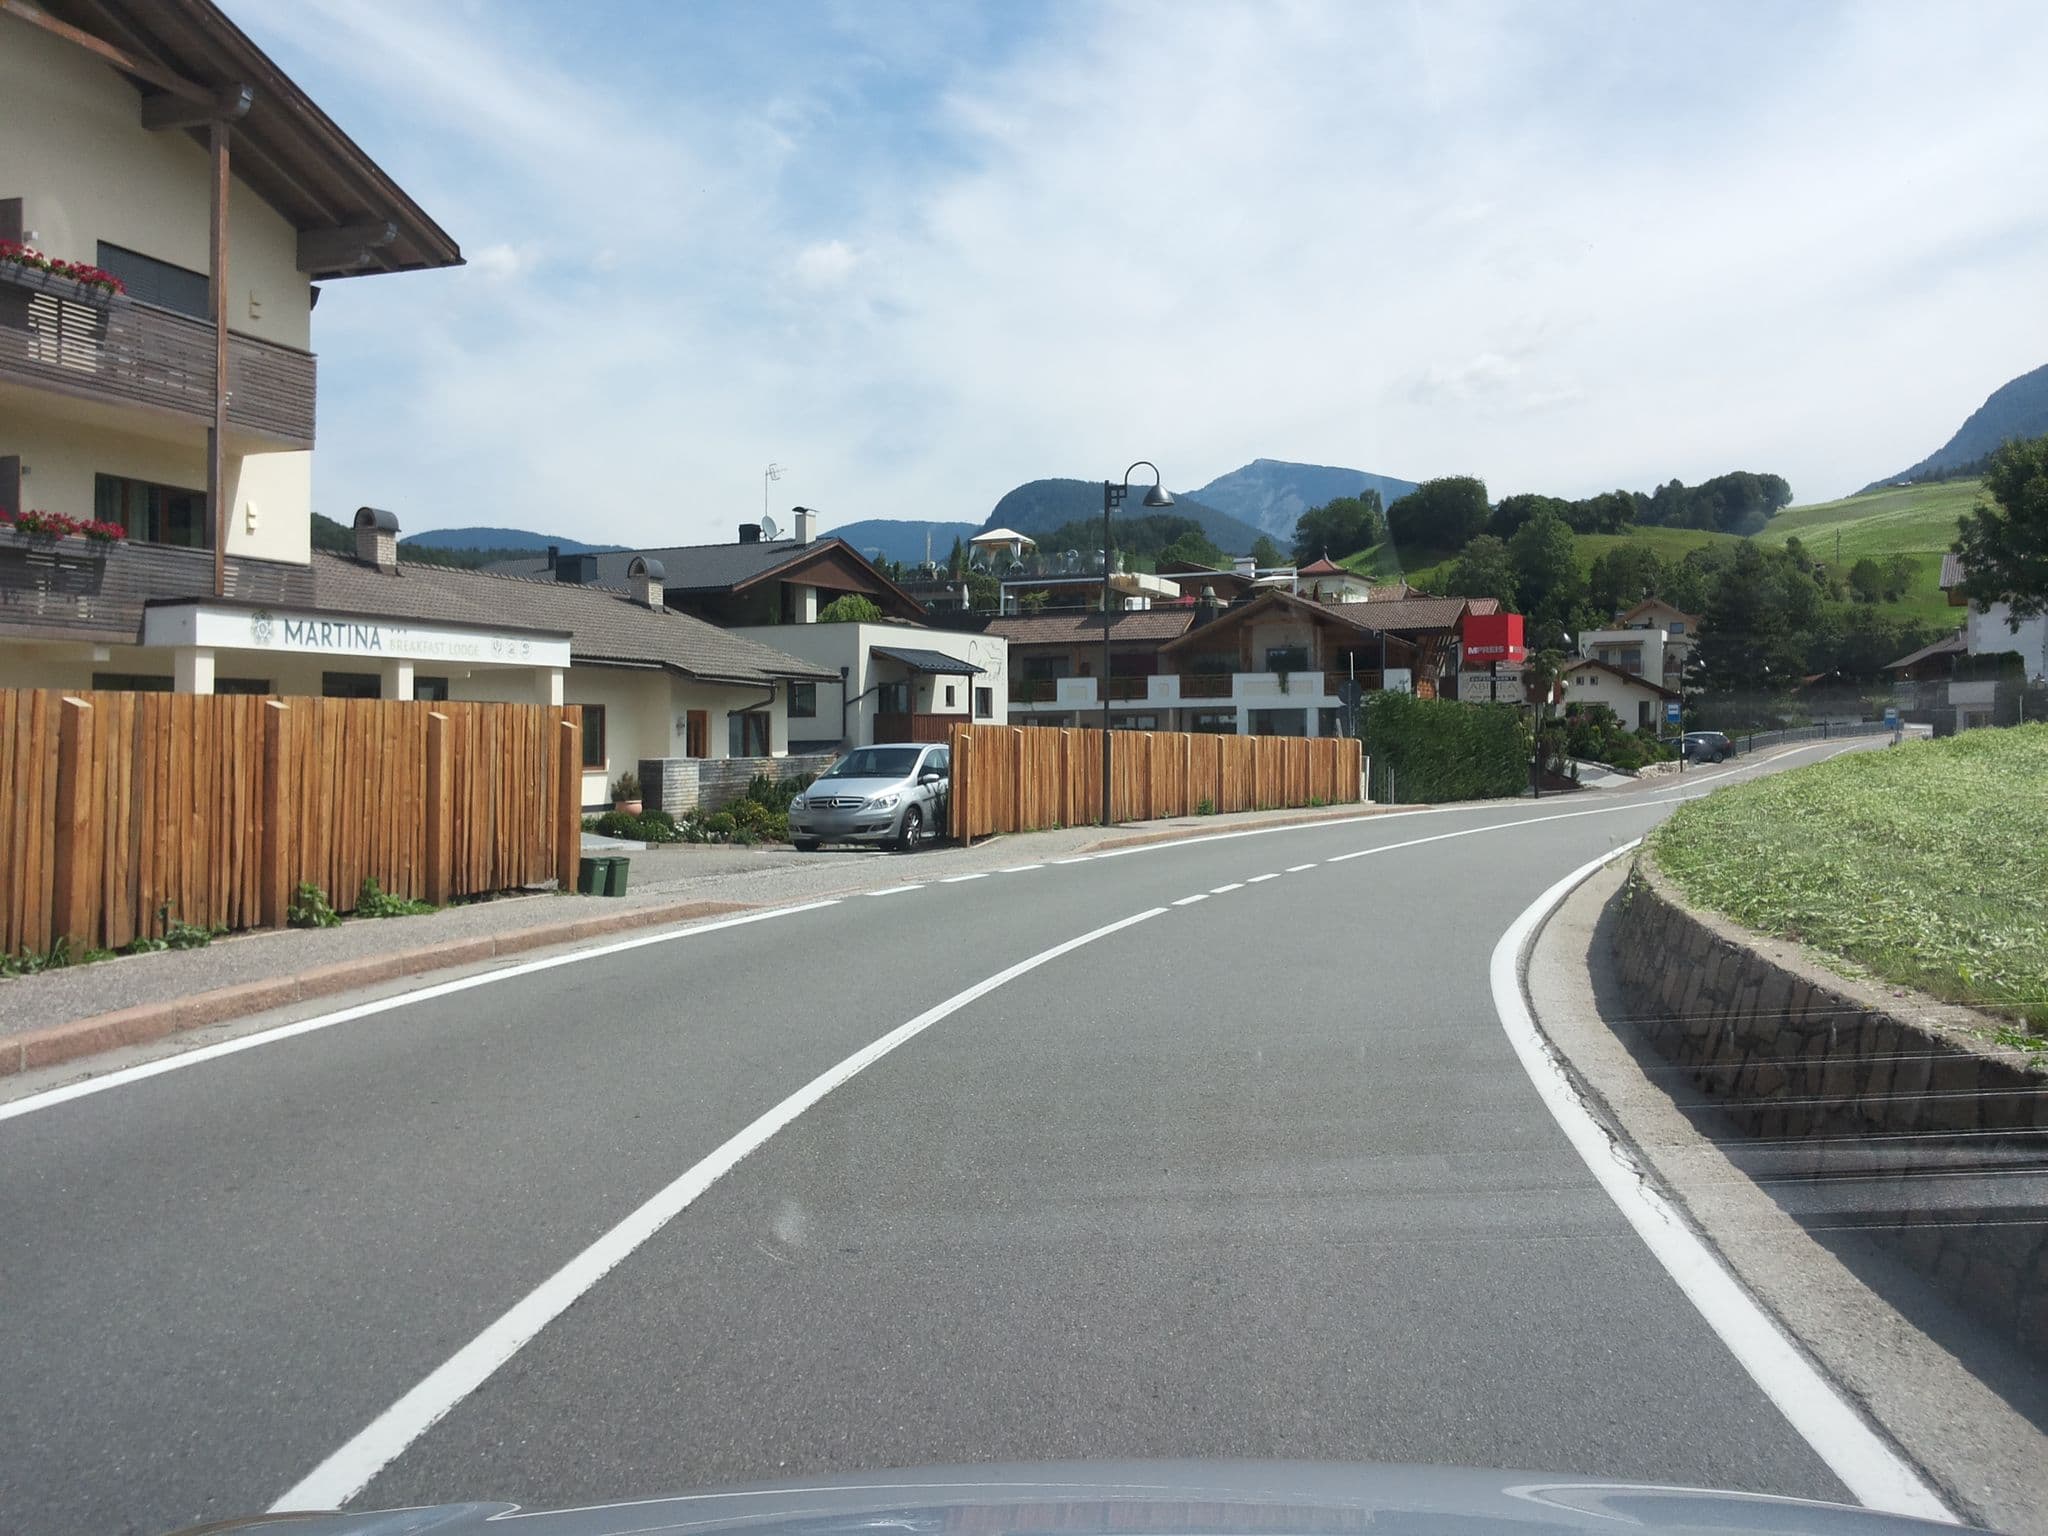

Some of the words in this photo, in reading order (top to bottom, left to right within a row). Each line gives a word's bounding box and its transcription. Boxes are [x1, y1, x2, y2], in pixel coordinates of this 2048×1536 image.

[284, 619, 382, 650] MARTINA
[390, 638, 445, 655] BREAKFAST
[448, 643, 480, 657] LODGE
[1468, 646, 1504, 654] MPREIS
